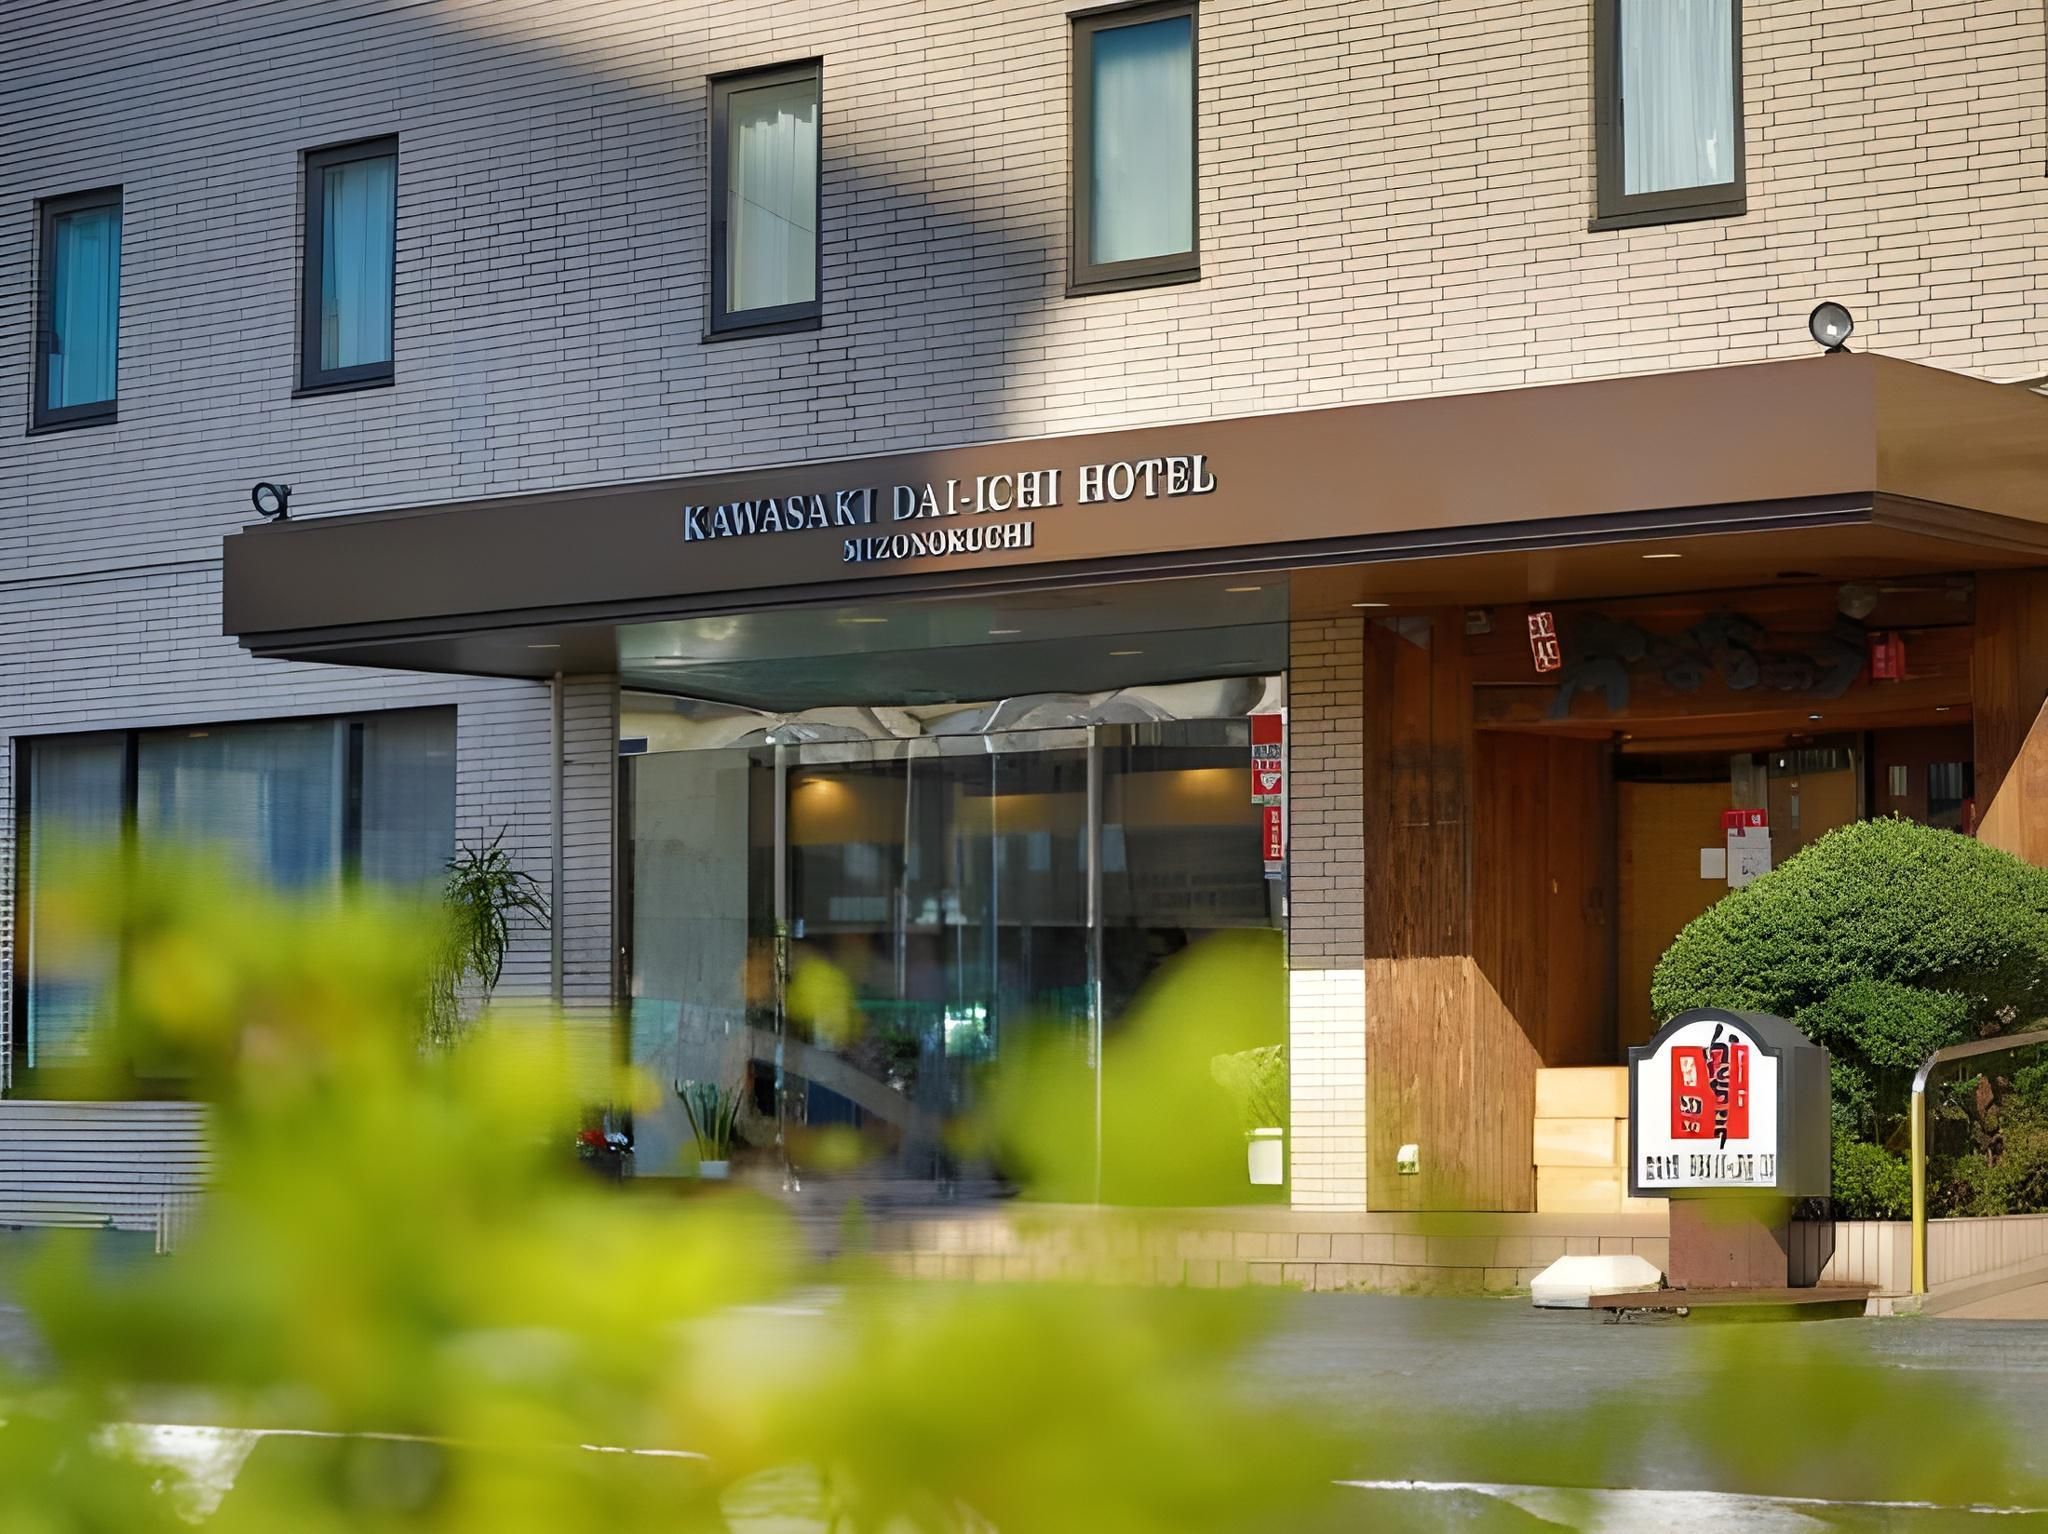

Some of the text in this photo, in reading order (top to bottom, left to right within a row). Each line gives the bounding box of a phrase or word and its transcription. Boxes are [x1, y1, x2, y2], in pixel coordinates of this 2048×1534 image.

[684, 454, 1216, 541] KAWASAKI DAI-ICHI HOTEL
